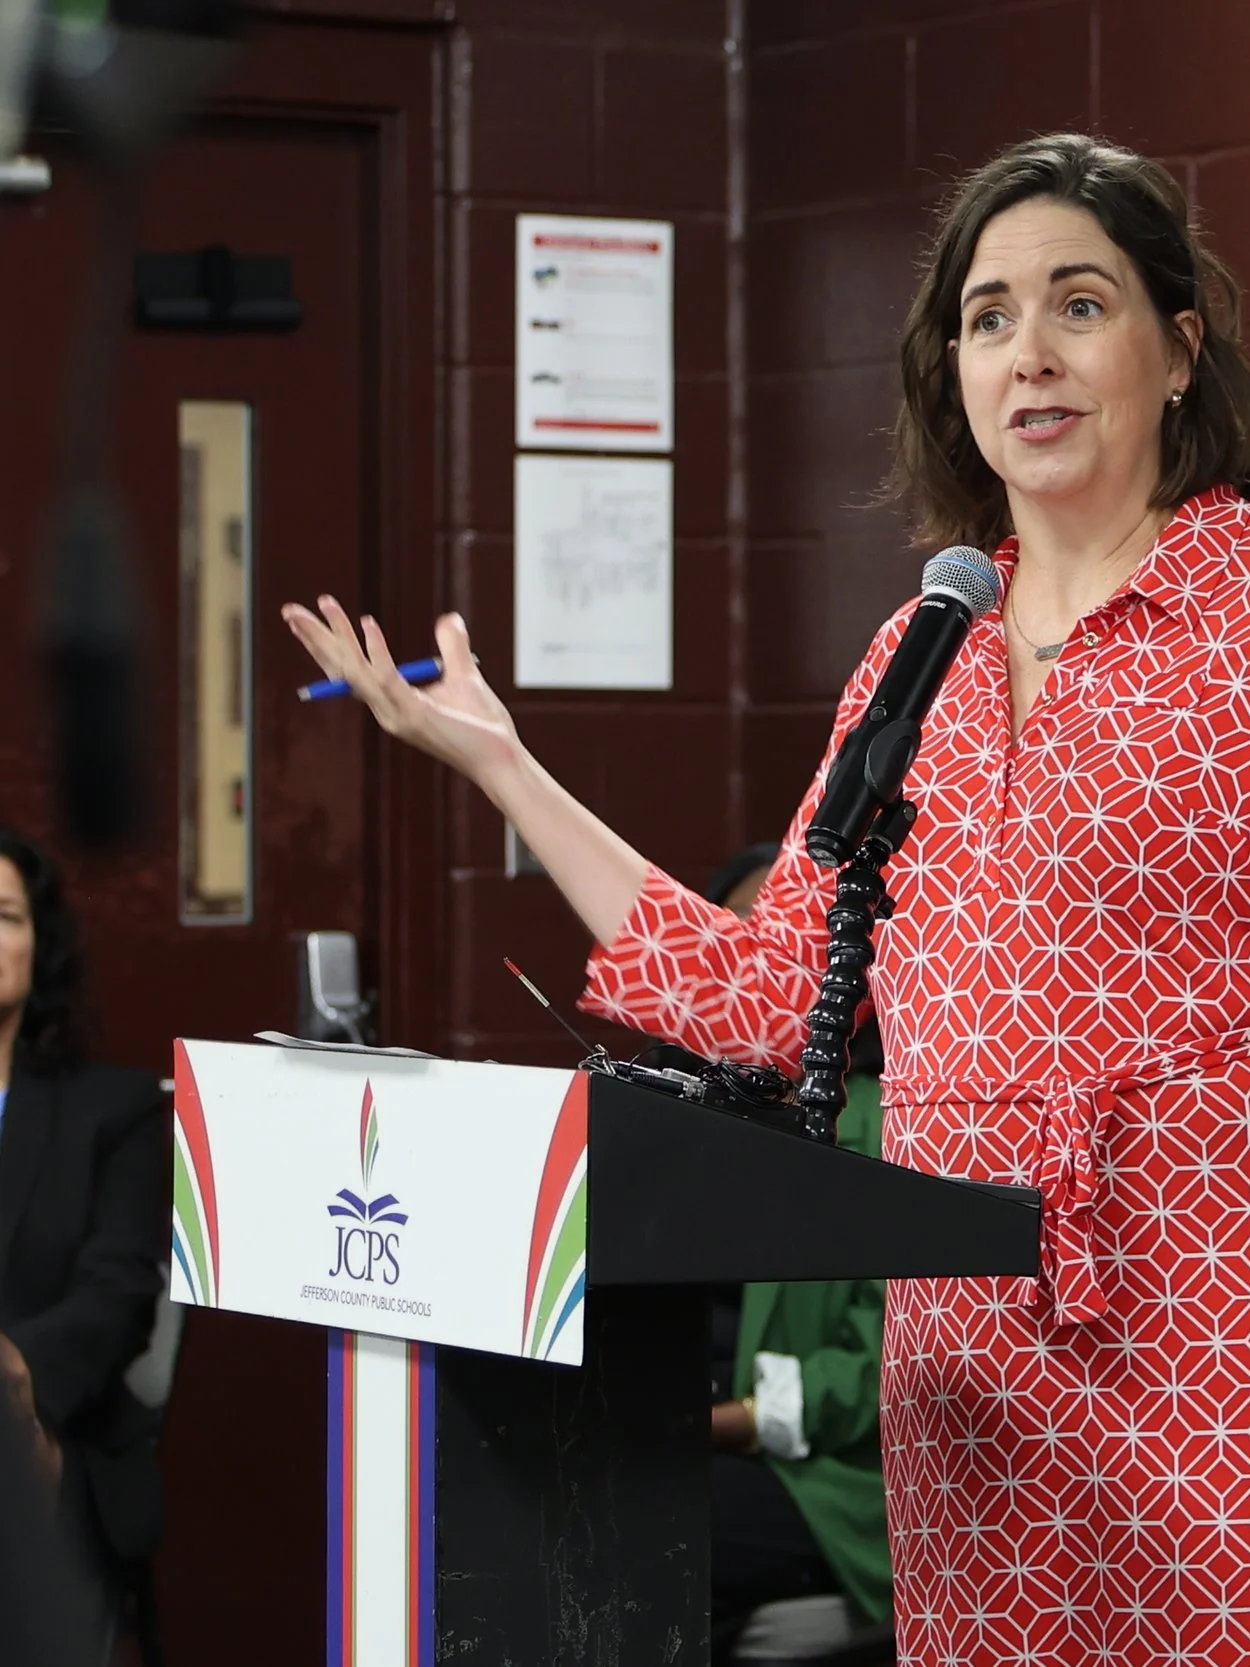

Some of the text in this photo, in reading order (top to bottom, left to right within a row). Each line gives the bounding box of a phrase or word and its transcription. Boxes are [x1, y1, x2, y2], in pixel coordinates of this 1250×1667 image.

[328, 1226, 400, 1285] JCPS
[300, 1285, 432, 1317] JEFFERSON COUNTY PUBLIC SCHOOLS
